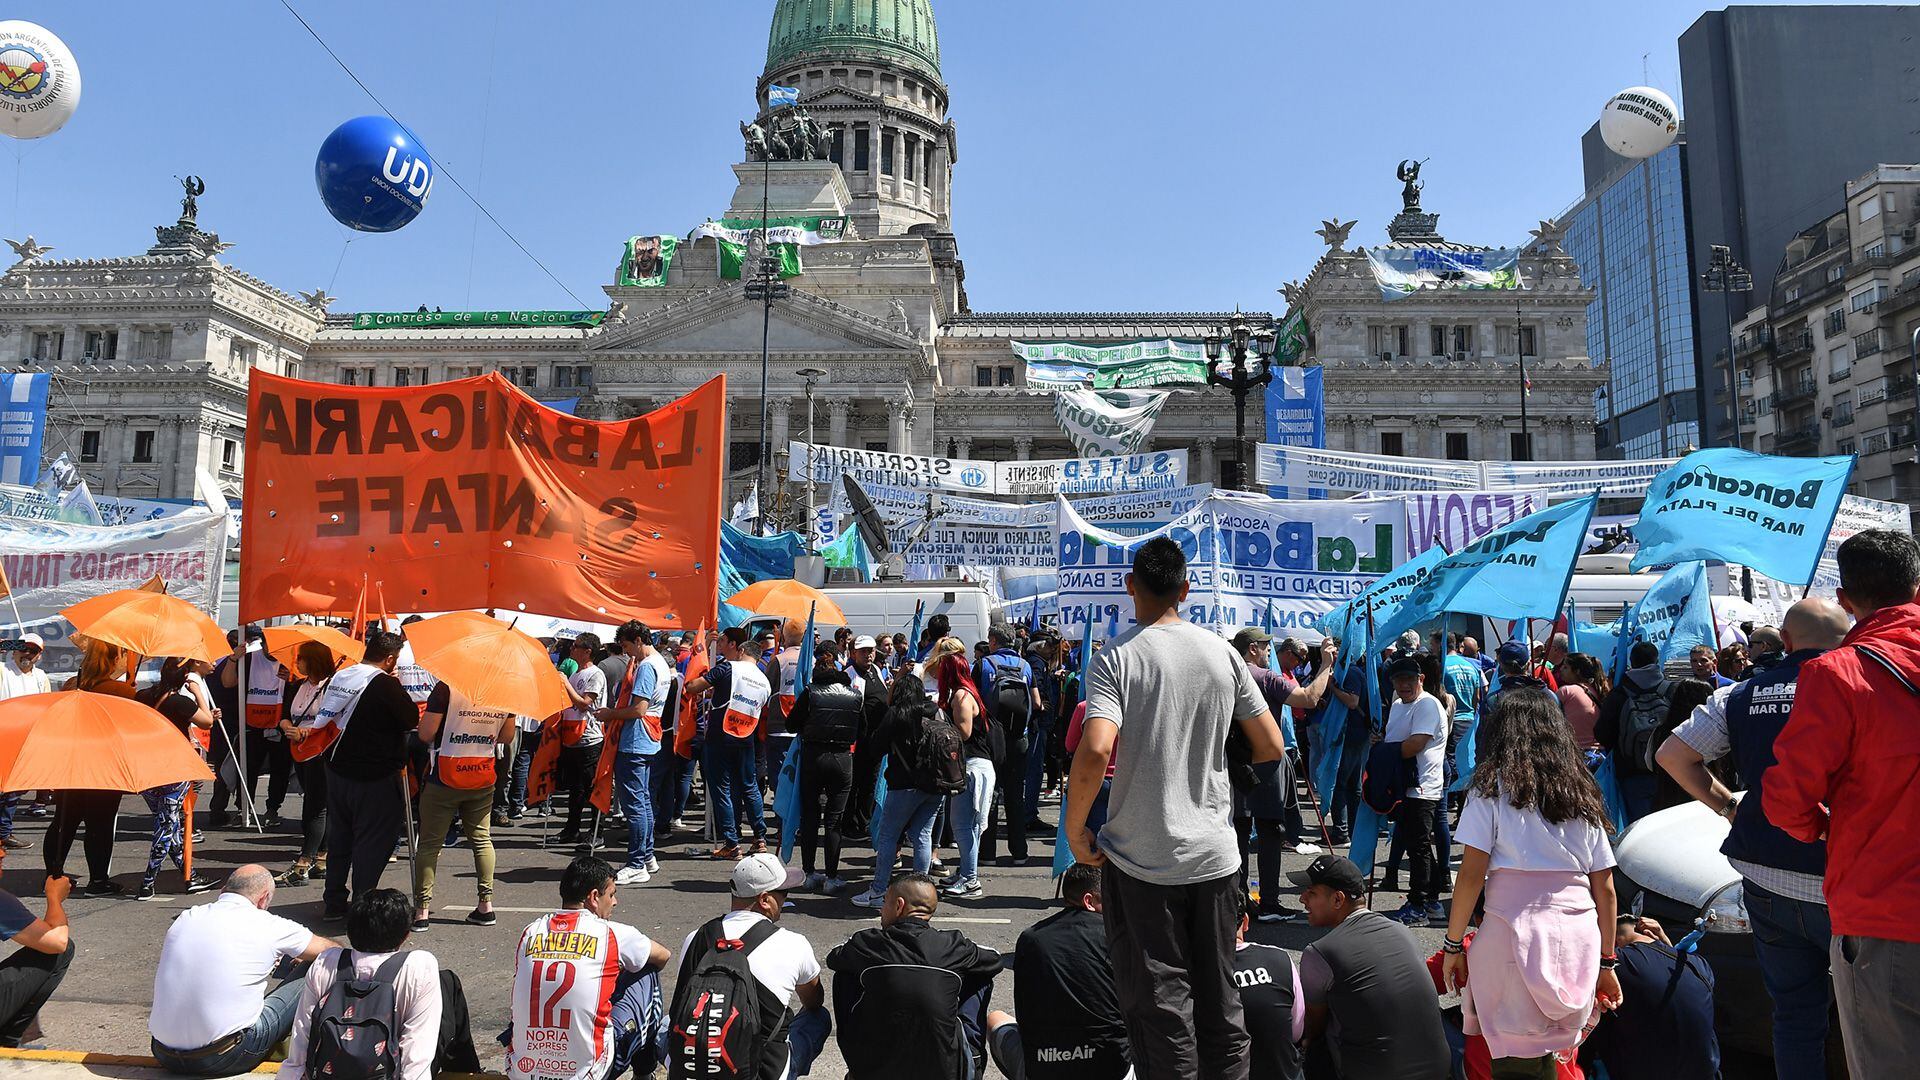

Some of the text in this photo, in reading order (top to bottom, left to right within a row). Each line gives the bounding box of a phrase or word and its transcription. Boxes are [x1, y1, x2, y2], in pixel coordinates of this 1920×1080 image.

[1617, 93, 1674, 121] ALIMENTACION
[1617, 103, 1664, 127] BUENOS AIRES
[382, 146, 434, 207] UD
[376, 313, 442, 324] Congreso
[453, 311, 472, 322] de
[482, 312, 499, 322] la
[509, 310, 567, 323] Nación
[1052, 345, 1142, 362] PROSPERO
[458, 710, 506, 720] SERGIO PALAZZ
[1749, 703, 1778, 716] MAR
[448, 732, 497, 746] LaBancari
[524, 931, 599, 960] LA NUEVA
[526, 959, 577, 1030] 12
[526, 1030, 569, 1042] NORIA
[526, 1041, 568, 1051] EXPRESS
[536, 1058, 577, 1071] AGOEC
